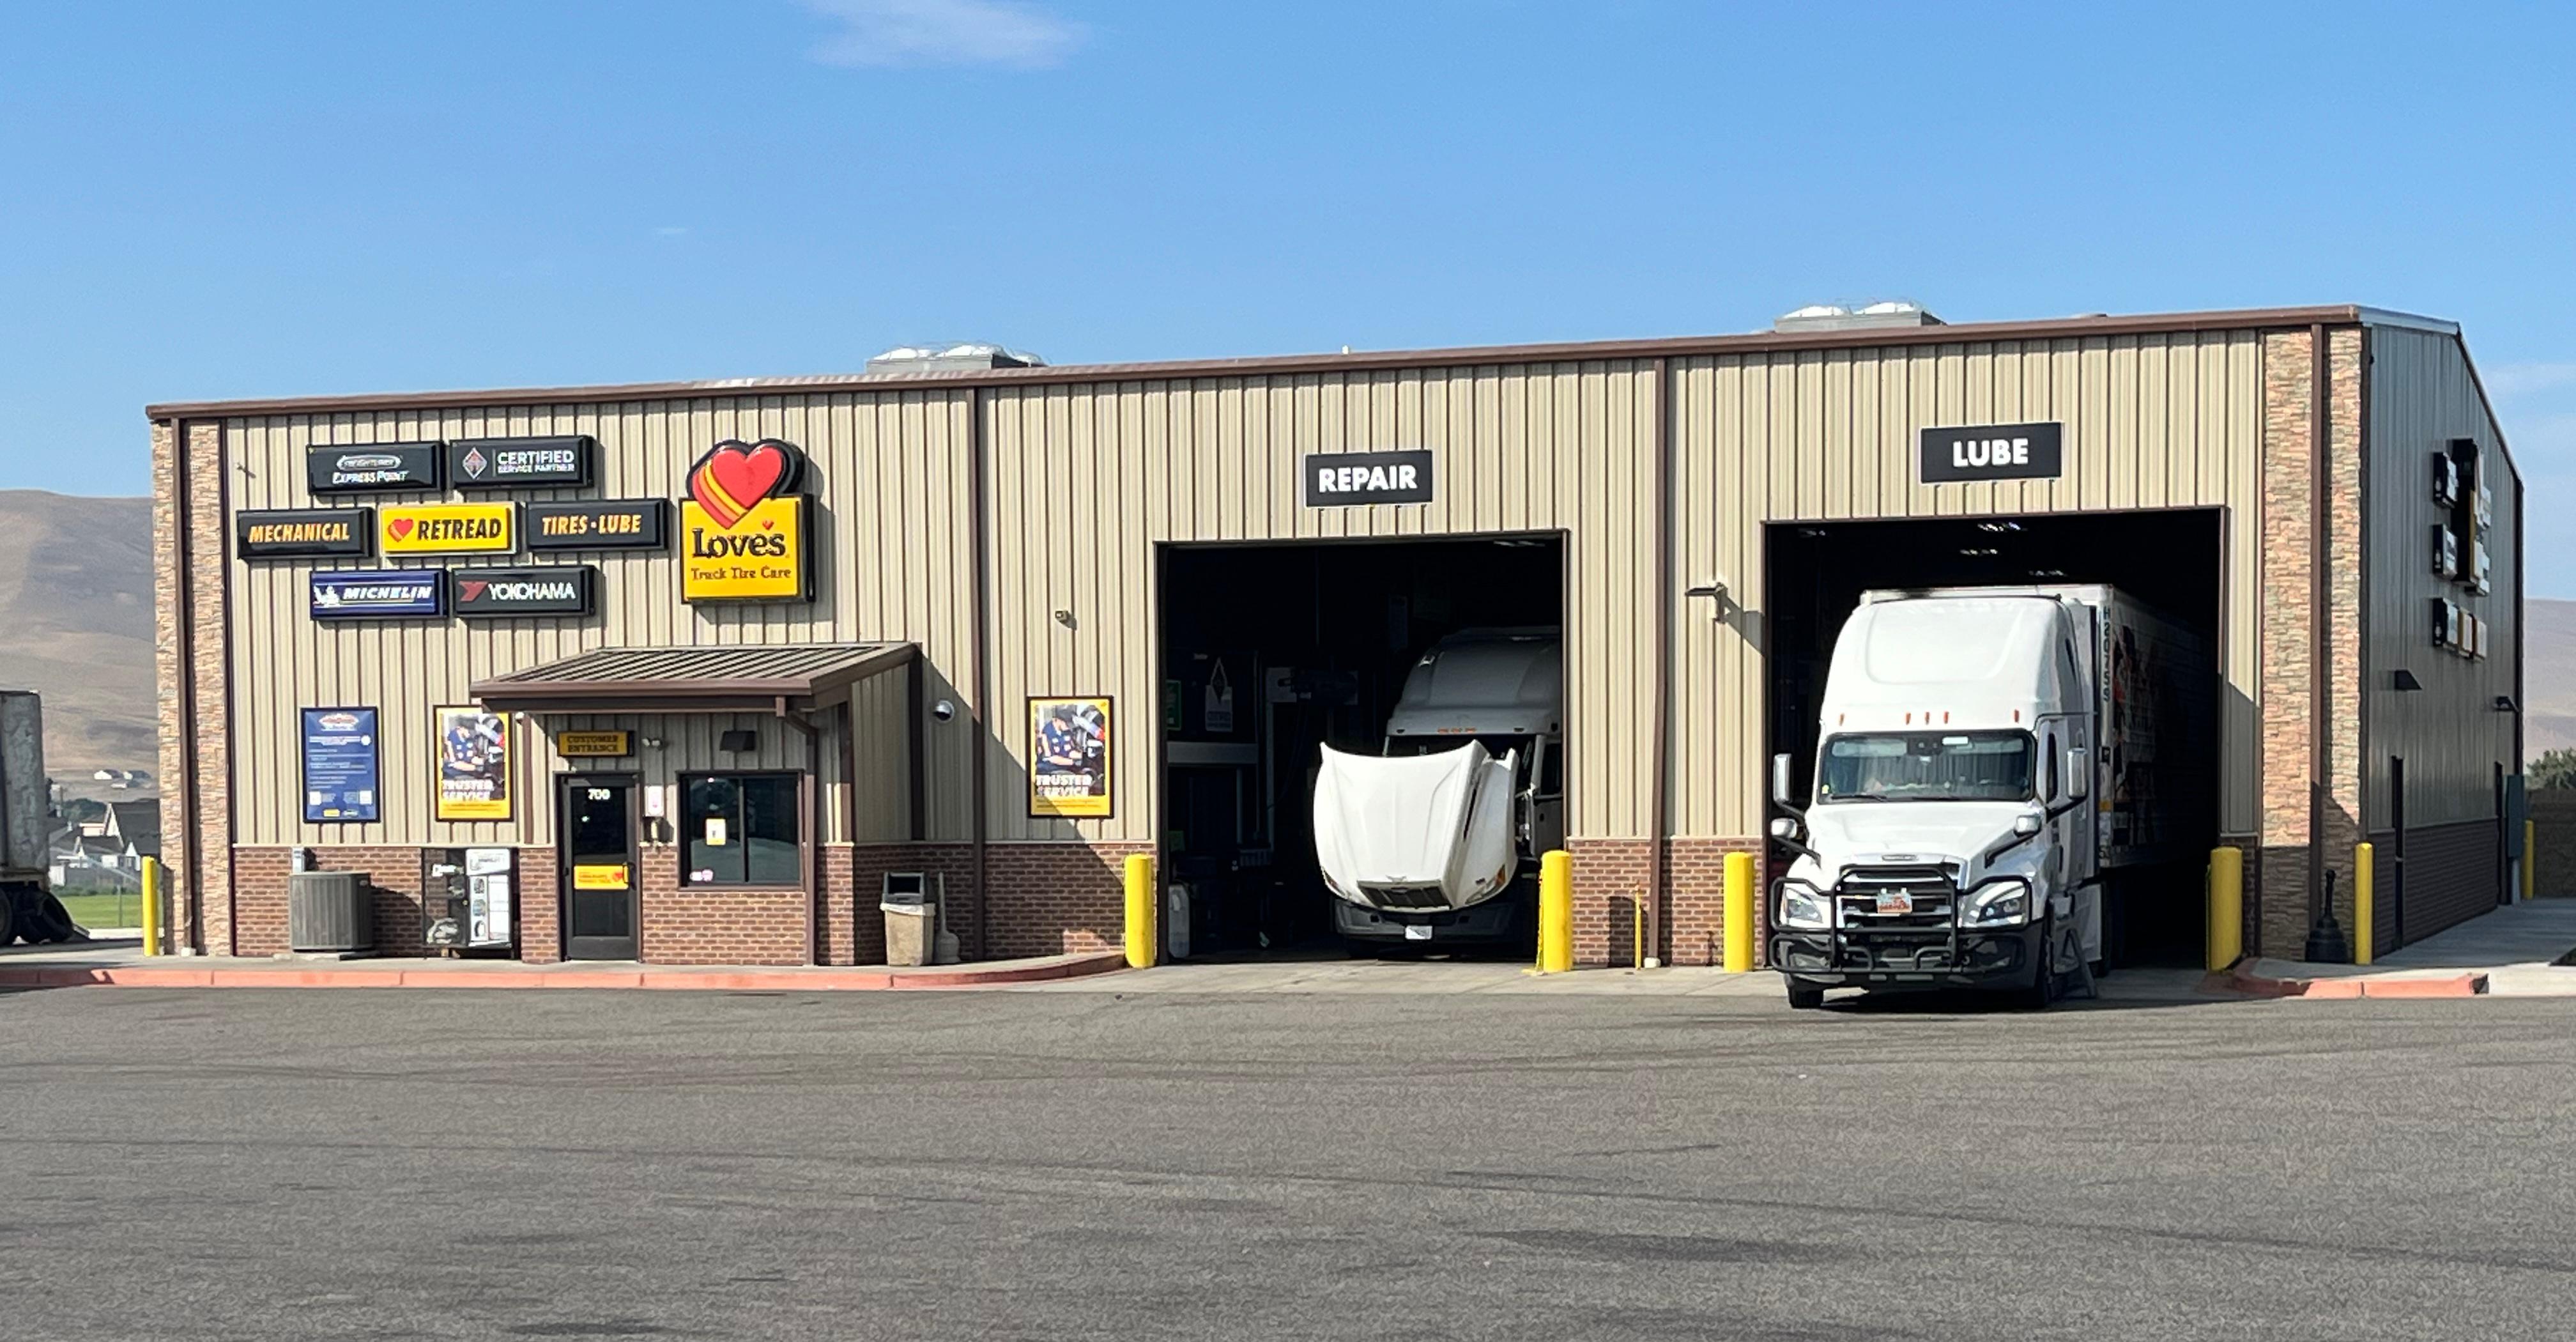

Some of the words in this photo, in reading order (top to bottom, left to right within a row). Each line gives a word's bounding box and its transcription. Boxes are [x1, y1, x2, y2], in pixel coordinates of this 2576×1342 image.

[497, 450, 574, 465] CERTIFIED
[1953, 438, 2028, 467] LUBE
[332, 472, 376, 484] EXPRESS
[377, 470, 409, 482] POINT
[1319, 465, 1417, 493] REPAIR
[248, 523, 350, 543] MECHANICAL
[417, 518, 502, 541] RETREAD
[691, 567, 727, 580] Truck
[731, 567, 756, 580] Tire
[760, 567, 792, 579] Care
[342, 585, 432, 601] MICHELIN
[489, 582, 576, 601] YOKOHAMA
[588, 789, 611, 800] 700
